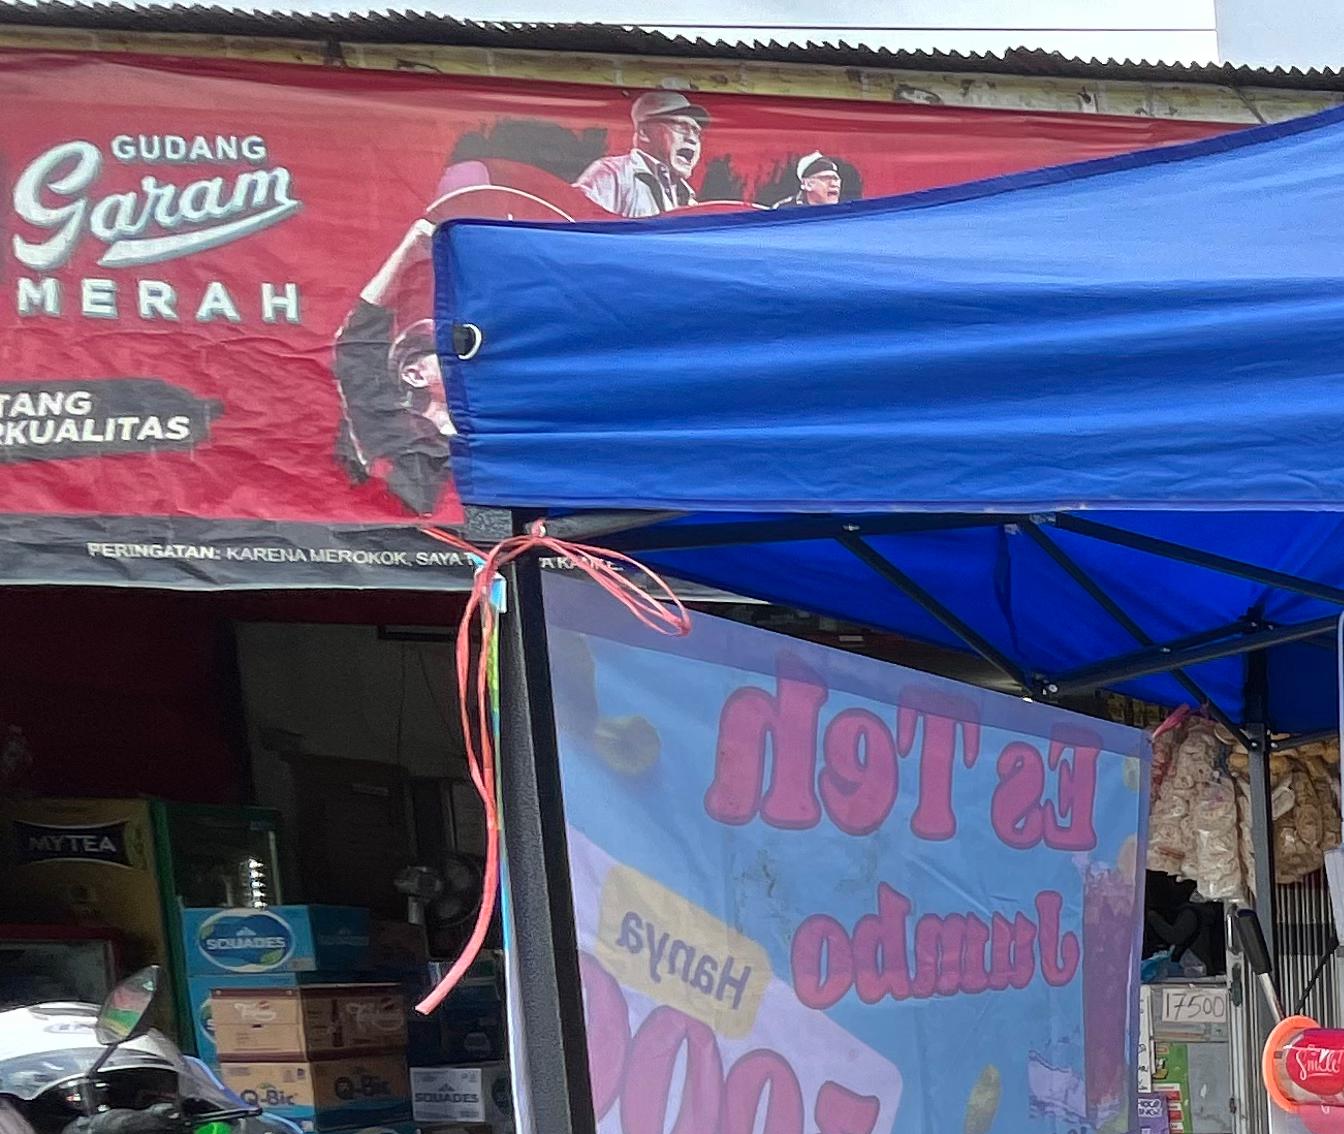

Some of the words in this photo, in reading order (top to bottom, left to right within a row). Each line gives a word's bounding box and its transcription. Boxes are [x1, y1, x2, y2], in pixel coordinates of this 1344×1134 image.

[111, 134, 268, 161] GUDANG
[12, 140, 301, 269] Garam
[17, 276, 300, 323] MERAH
[0, 415, 191, 446] KUALITAS
[86, 542, 222, 561] PERINGATAN:
[226, 547, 307, 563] KARENA
[309, 548, 413, 567] MEROKOK,
[415, 550, 461, 567] SAYA
[29, 834, 118, 853] MYTEA
[1165, 992, 1226, 1020] 17500
